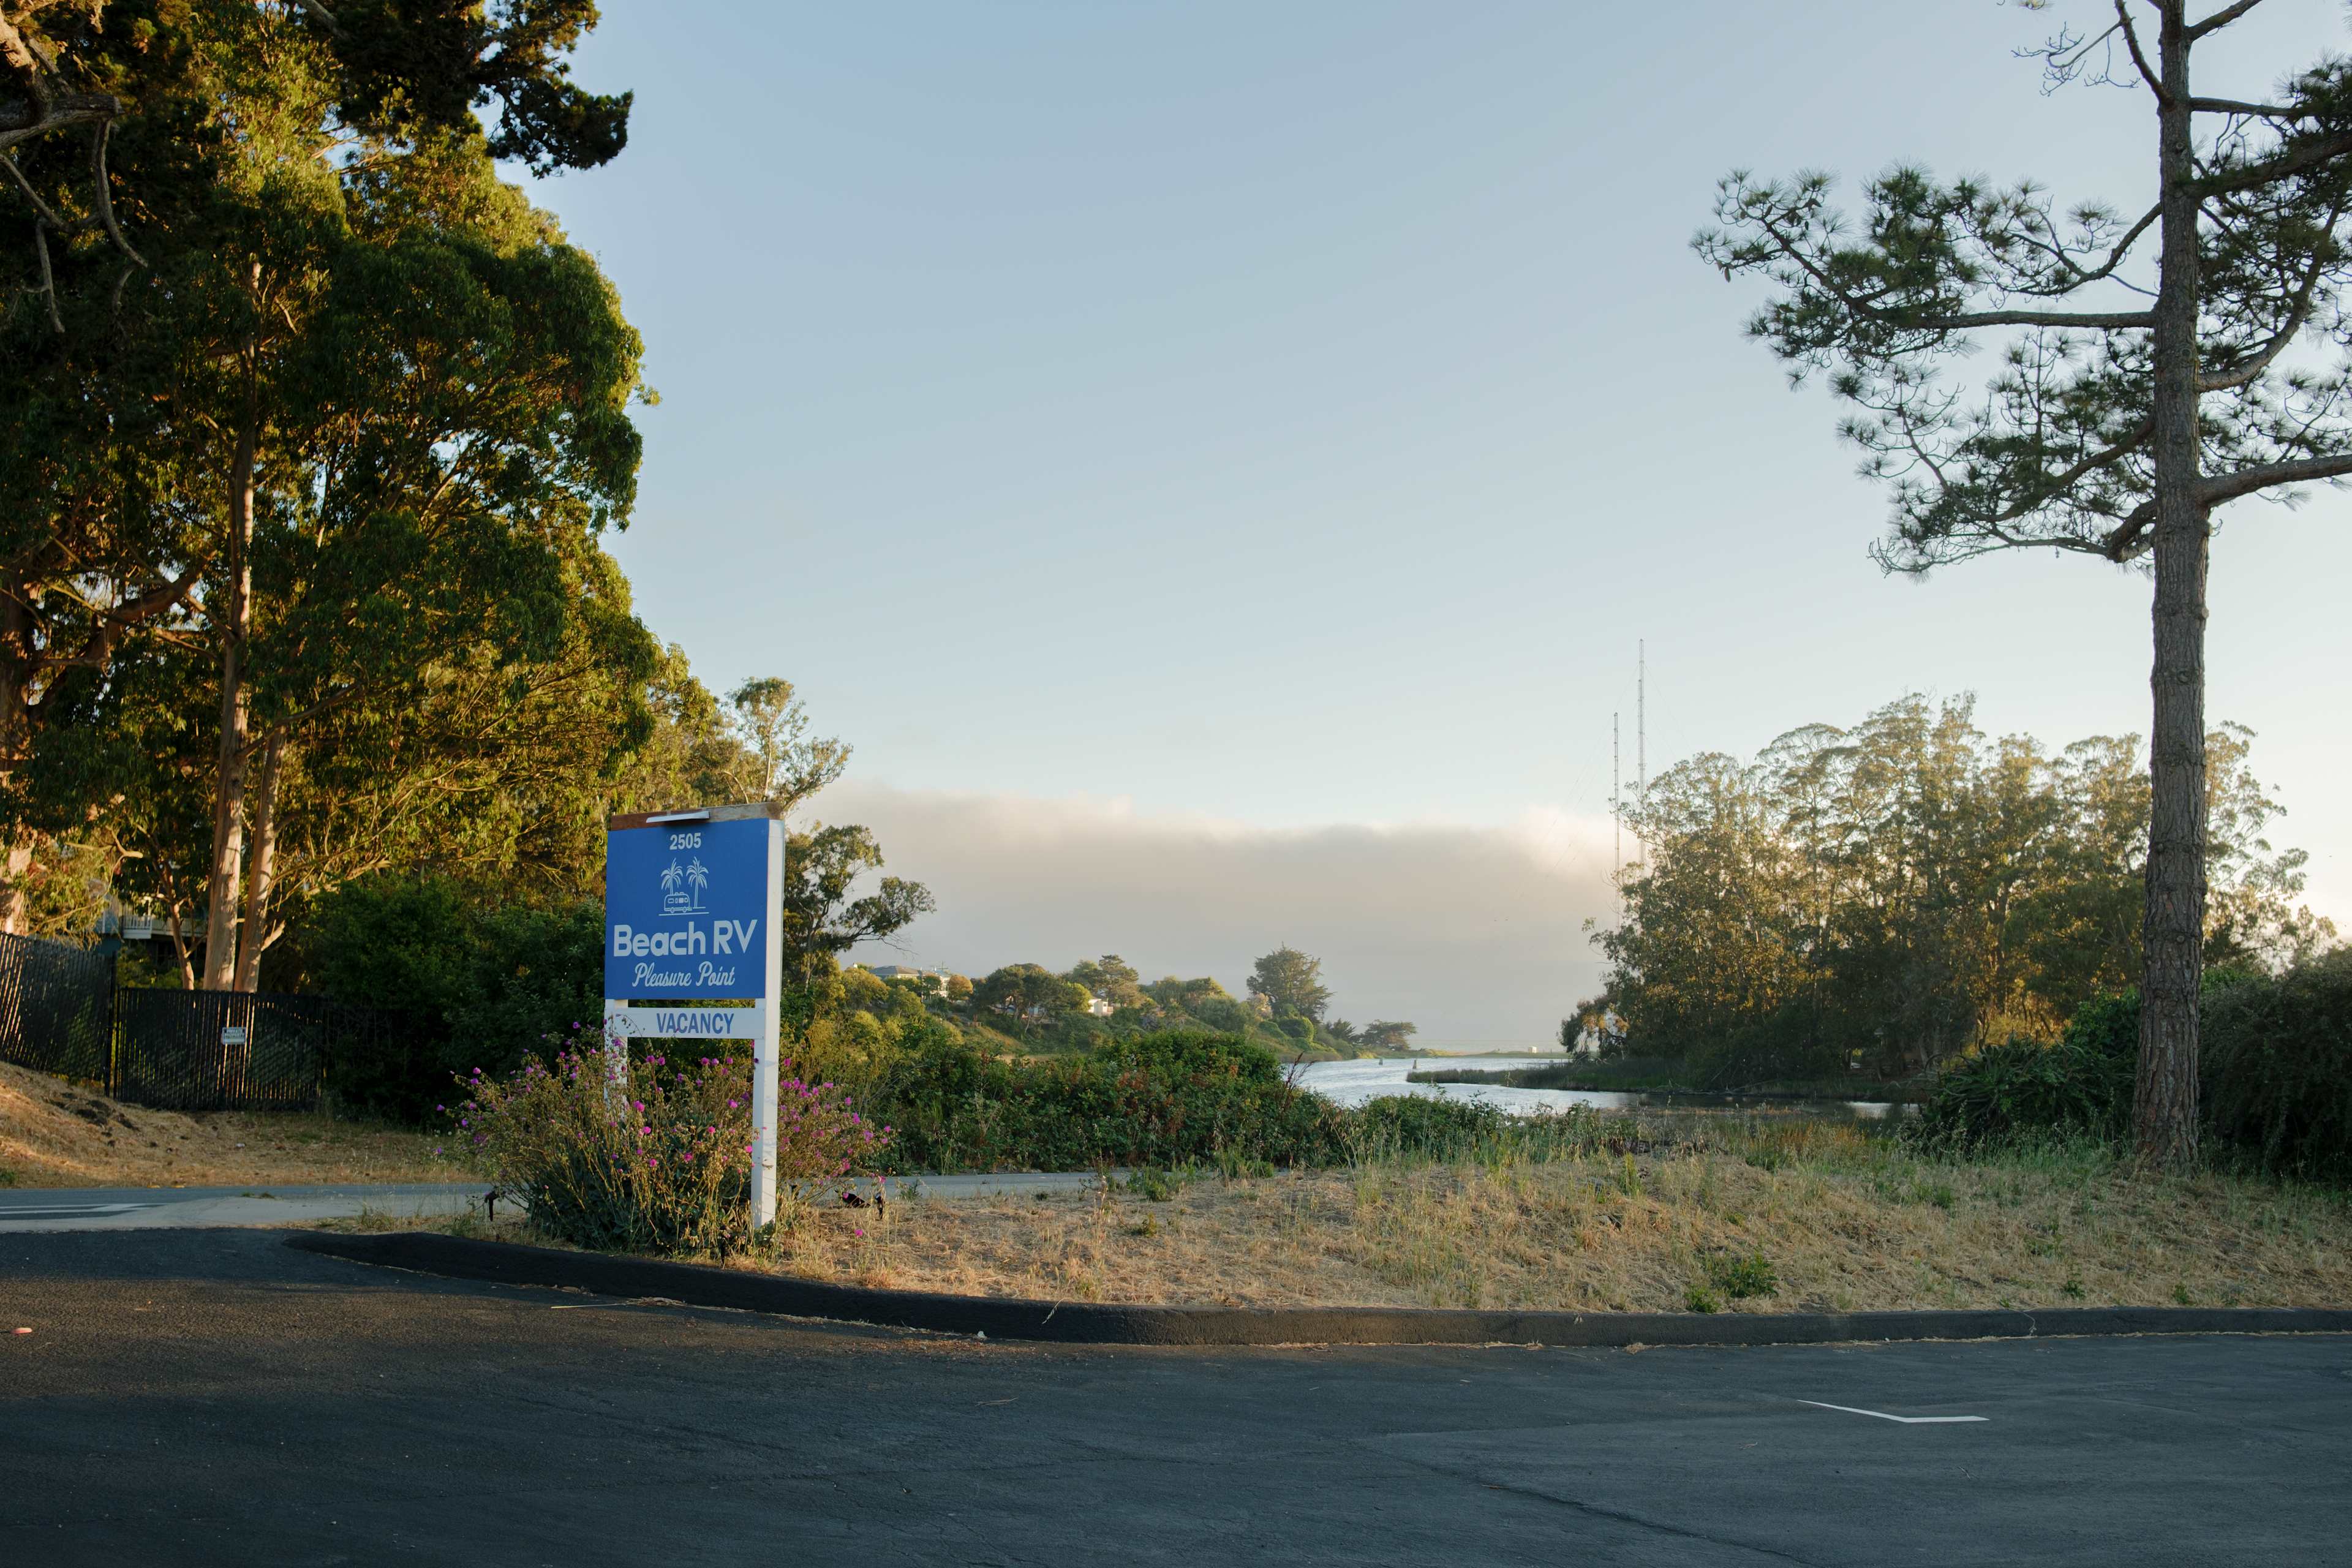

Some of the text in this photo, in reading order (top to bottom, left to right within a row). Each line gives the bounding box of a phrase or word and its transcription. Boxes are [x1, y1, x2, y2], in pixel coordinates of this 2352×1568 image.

[669, 832, 702, 850] 2505
[613, 919, 758, 957] Beach RV
[632, 961, 736, 987] Pleasure Point
[657, 1012, 734, 1035] VACANCY
